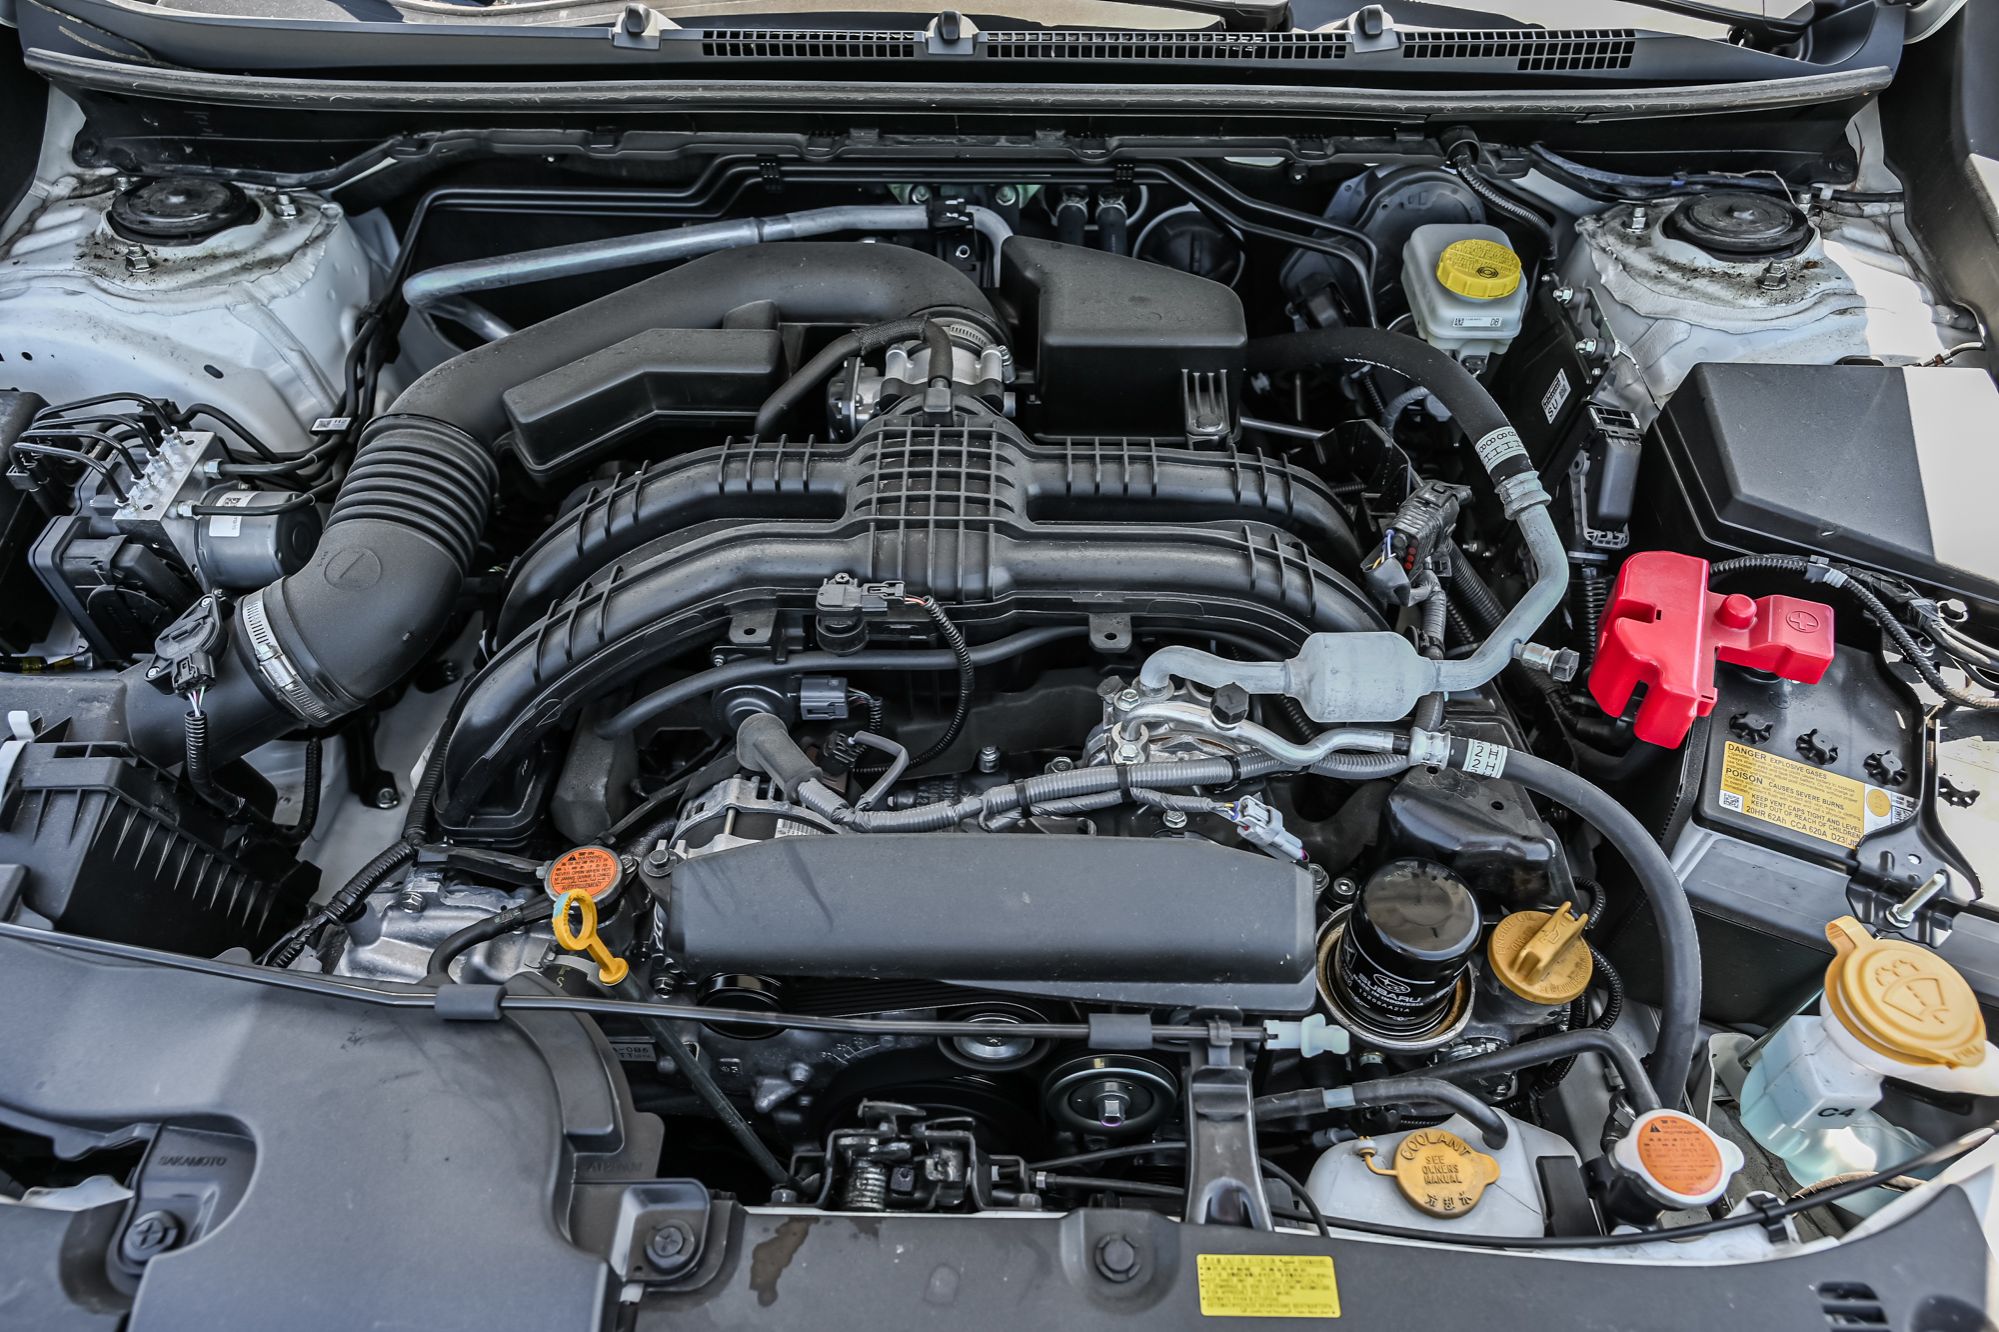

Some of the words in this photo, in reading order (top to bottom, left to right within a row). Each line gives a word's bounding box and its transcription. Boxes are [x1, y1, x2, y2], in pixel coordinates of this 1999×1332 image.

[1727, 743, 1766, 761] DANGER
[1769, 756, 1804, 772] EXPLOSIVE
[1805, 767, 1827, 780] GASES
[1725, 766, 1763, 785] POISON
[1768, 781, 1794, 794] CAUSES
[1795, 789, 1820, 803] SEVERE
[1821, 798, 1844, 810] BURNS
[1746, 805, 1765, 818] 20HR
[1767, 812, 1786, 825] 62Ah
[1790, 819, 1807, 832] CCA
[1808, 825, 1827, 838] 620A
[1750, 798, 1768, 809] KEEP
[1769, 804, 1783, 814] OUT
[1784, 809, 1792, 817] OF
[1794, 812, 1816, 825] REACH
[1818, 820, 1827, 828] OF
[1828, 823, 1860, 839] CHILDREN
[1751, 792, 1768, 803] KEEP
[1769, 798, 1786, 809] VENT
[1787, 804, 1805, 815] CAPS
[1806, 810, 1825, 821] TIGHT
[1826, 817, 1840, 826] AND
[1841, 821, 1861, 833] LEVEL
[1353, 974, 1370, 991] MADE
[1381, 995, 1424, 1007] INDONESIA
[1359, 973, 1422, 1003] SUBARU
[1818, 1107, 1856, 1118] C4
[1400, 1132, 1471, 1161] COOLANT
[1425, 1155, 1445, 1164] SEE
[1424, 1174, 1463, 1185] MANUAL
